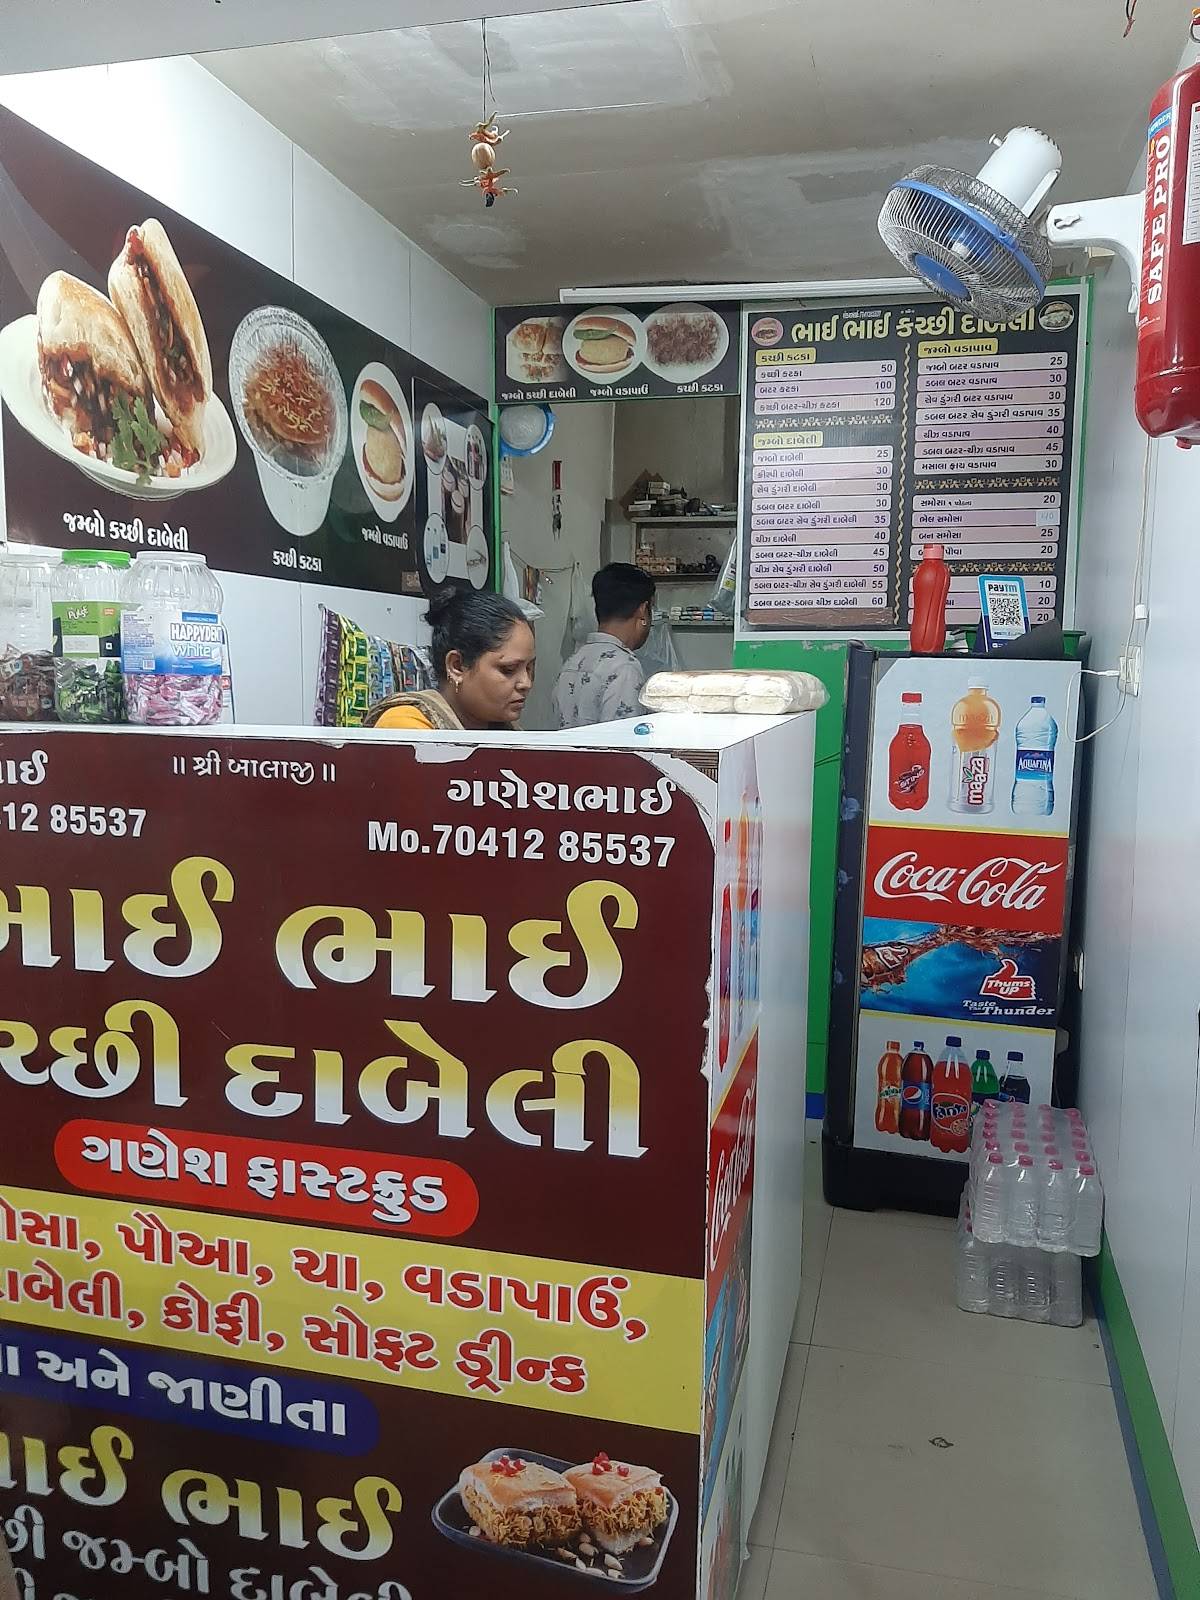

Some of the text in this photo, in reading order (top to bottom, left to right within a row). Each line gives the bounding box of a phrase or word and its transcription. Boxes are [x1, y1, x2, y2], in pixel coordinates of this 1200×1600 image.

[1154, 135, 1170, 210] PRO
[1147, 213, 1166, 305] SAFE
[791, 315, 839, 343] ભાઈ
[843, 312, 891, 340] ભાઈ
[1050, 357, 1063, 365] 25
[881, 364, 892, 372] 50
[1050, 374, 1062, 382] 30
[702, 383, 723, 392] કટકા
[875, 381, 891, 389] 100
[550, 387, 576, 399] દાબેલી
[874, 398, 891, 406] 120
[1012, 409, 1043, 417] વડાપાવ
[1048, 409, 1060, 417] 35
[1047, 426, 1059, 434] 40
[1046, 443, 1058, 451] 45
[1045, 460, 1057, 468] 30
[876, 483, 888, 491] 30
[876, 499, 887, 507] 30
[921, 498, 945, 506] સમોસા
[1043, 495, 1055, 503] 20
[148, 524, 189, 550] દાબેલી
[874, 532, 886, 540] 40
[936, 530, 961, 538] સમોસા
[1041, 529, 1053, 537] 25
[773, 534, 796, 542] દાબેલી
[814, 549, 838, 557] દાબેલી
[873, 548, 884, 556] 45
[1041, 546, 1053, 554] 20
[298, 554, 322, 572] કટકા
[844, 579, 866, 588] દાબેલી
[872, 597, 883, 605] 60
[1038, 597, 1050, 605] 20
[1037, 613, 1049, 622] 20
[0, 750, 49, 786] ાઈ
[192, 750, 314, 784] શ્રી બાલાજી
[1018, 757, 1052, 772] AQUAFINA
[968, 756, 986, 805] maaza
[447, 769, 677, 815] ગણેશભાઈ
[0, 802, 147, 838] 12 85537
[368, 821, 676, 868] Mo.70412 85537
[874, 851, 1063, 910] Coca-Cola
[275, 879, 639, 1009] ભાઈ
[987, 979, 1030, 988] Thums
[982, 1006, 1055, 1015] Thunder
[224, 1018, 649, 1159] દાબેલી
[81, 1128, 228, 1185] ગણેશ
[292, 1247, 385, 1303] ચા,
[403, 1265, 648, 1343] વડાપાઉં,
[0, 1258, 146, 1329] ાબેલી,
[161, 1281, 286, 1353] કોફી,
[35, 1348, 130, 1397] અને
[148, 1371, 346, 1436] જાણીતા
[0, 1425, 402, 1561] ાઈ ભાઈ
[62, 1530, 210, 1594] જમ્બો
